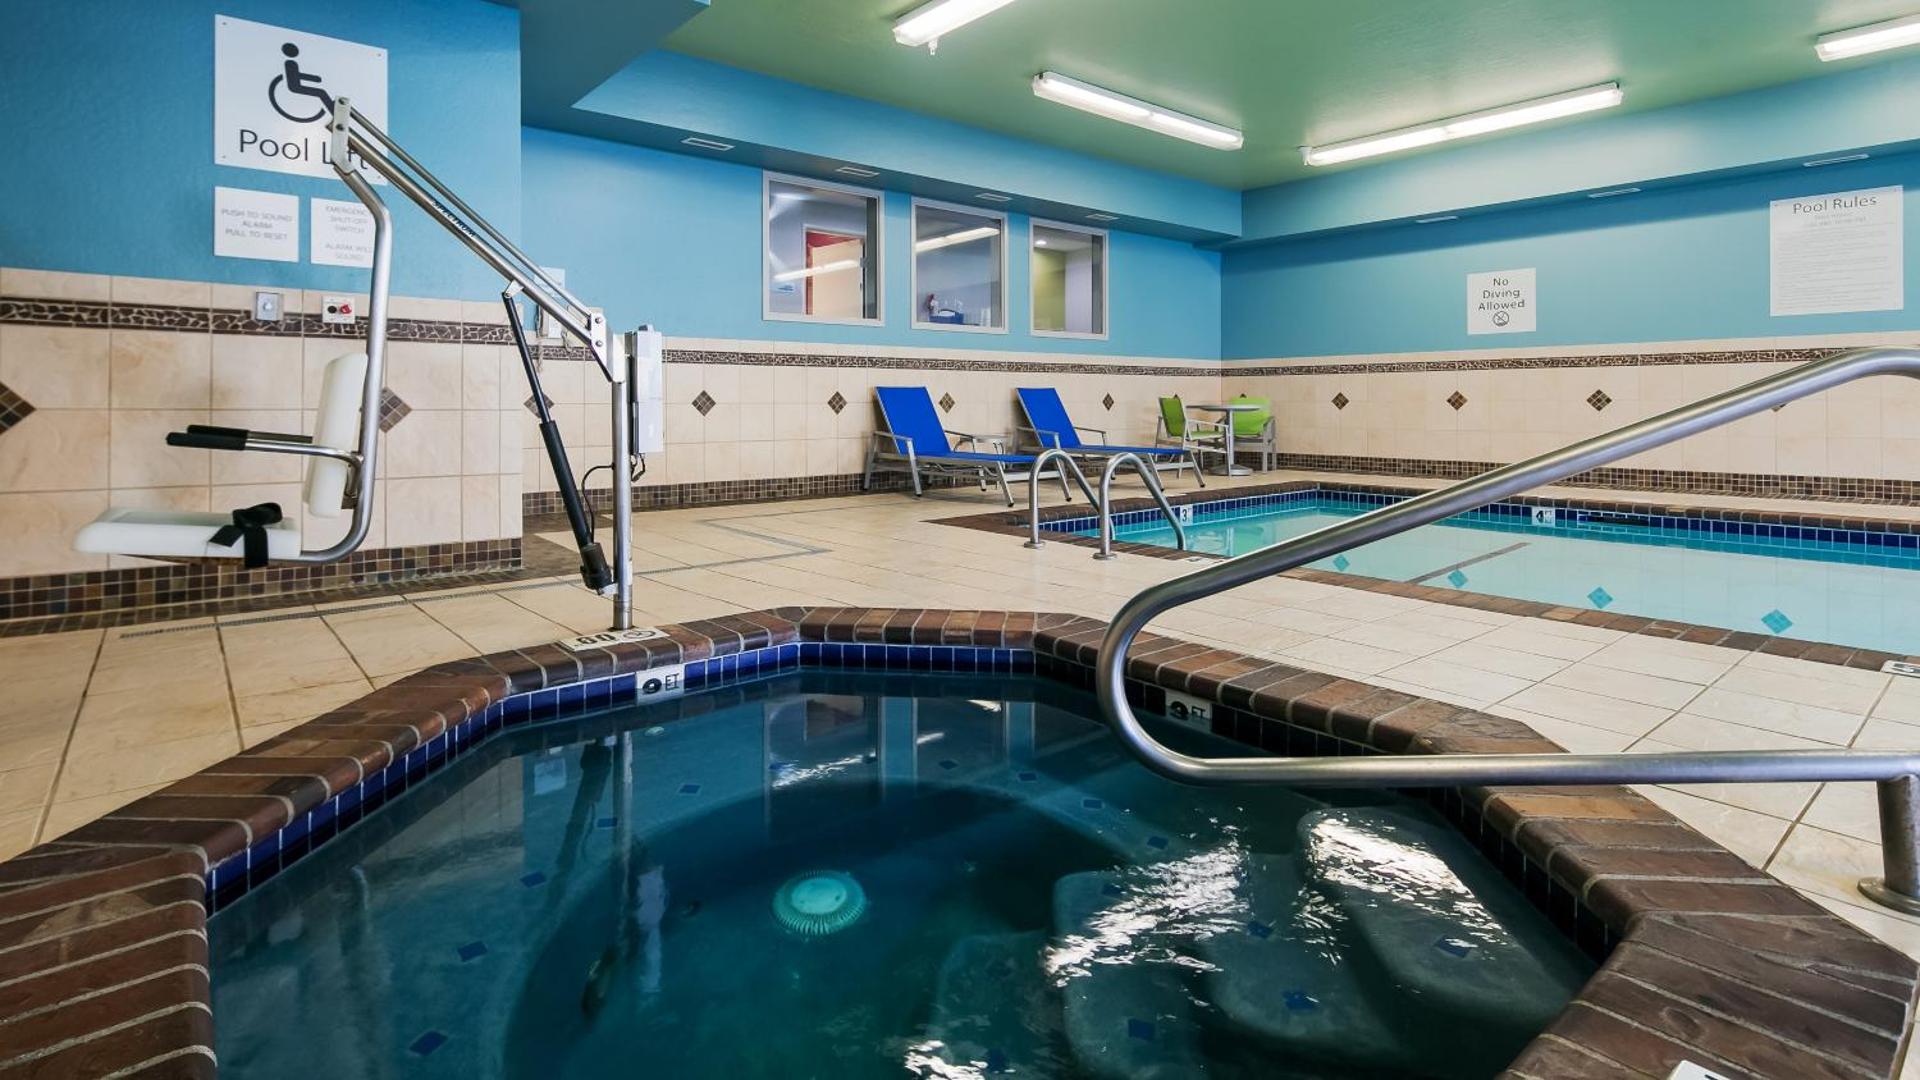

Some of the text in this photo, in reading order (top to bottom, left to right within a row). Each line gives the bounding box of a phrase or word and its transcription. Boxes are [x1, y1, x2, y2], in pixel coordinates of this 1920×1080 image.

[239, 129, 309, 162] Pool
[1792, 195, 1878, 214] Pool Rules
[1493, 278, 1509, 286] No
[1482, 289, 1520, 299] Diving
[1478, 299, 1525, 311] Allowed
